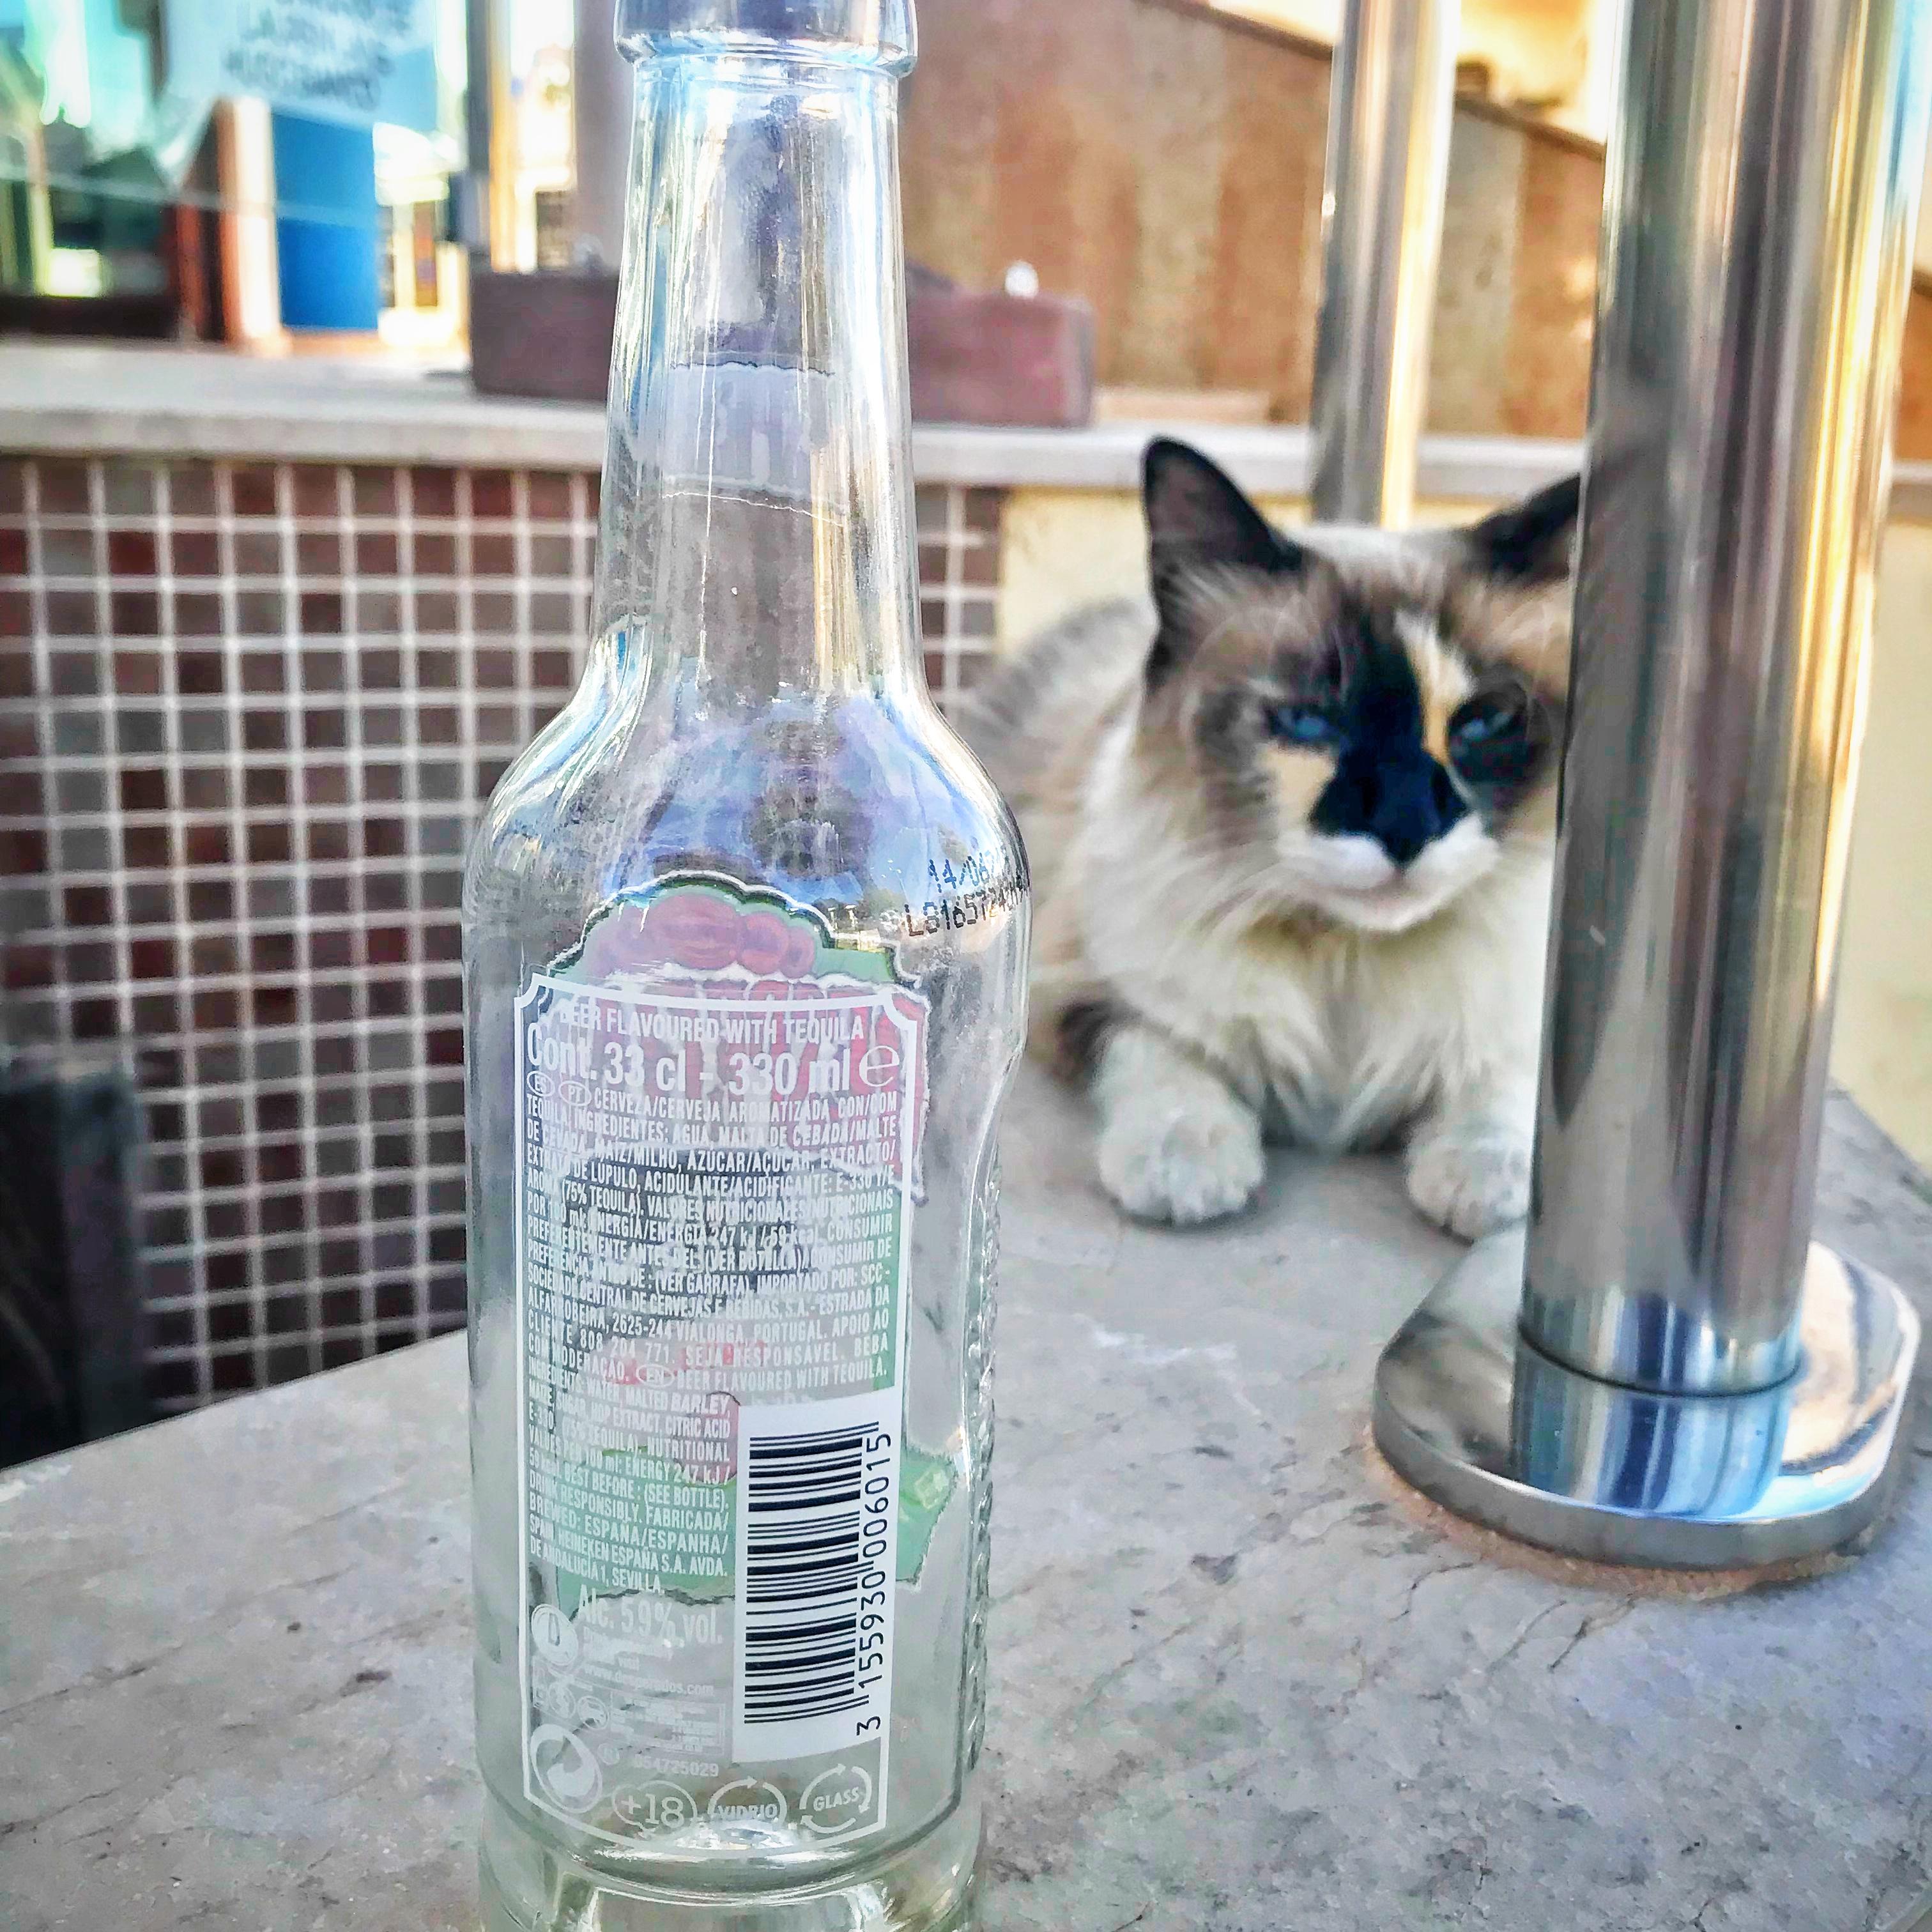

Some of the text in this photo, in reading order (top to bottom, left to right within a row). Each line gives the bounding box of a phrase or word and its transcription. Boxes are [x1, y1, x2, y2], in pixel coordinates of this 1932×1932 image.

[607, 1008, 719, 1043] FLAVOURED
[726, 1018, 777, 1045] WITH
[783, 1015, 863, 1045] TEQUILA
[527, 1022, 597, 1080] Cont.
[604, 1041, 645, 1087] 33
[656, 1048, 686, 1091] cl
[728, 1052, 797, 1096] 330
[808, 1048, 850, 1093] ml
[527, 1119, 540, 1142] DE
[770, 1126, 787, 1147] DE
[562, 1179, 587, 1206] (75%
[527, 1190, 546, 1216] POR
[827, 1213, 893, 1242] CONSUMIR
[878, 1236, 892, 1257] DE
[875, 1284, 890, 1307] DA
[832, 1311, 870, 1337] APOIO
[873, 1307, 889, 1330] AO
[580, 1328, 603, 1353] 808
[610, 1335, 636, 1358] 204
[686, 1344, 723, 1368] SEJA
[854, 1331, 889, 1357] BEBA
[797, 1366, 829, 1390] WITH
[666, 1415, 702, 1438] CITRIC
[704, 1418, 731, 1439] ACID
[647, 1436, 731, 1462] NUTRITIONAL
[674, 1463, 700, 1484] 247
[530, 1535, 542, 1558] DE
[558, 1527, 610, 1562] HEINEKEN
[620, 1793, 686, 1828] +18
[812, 1786, 860, 1812] GLASS
